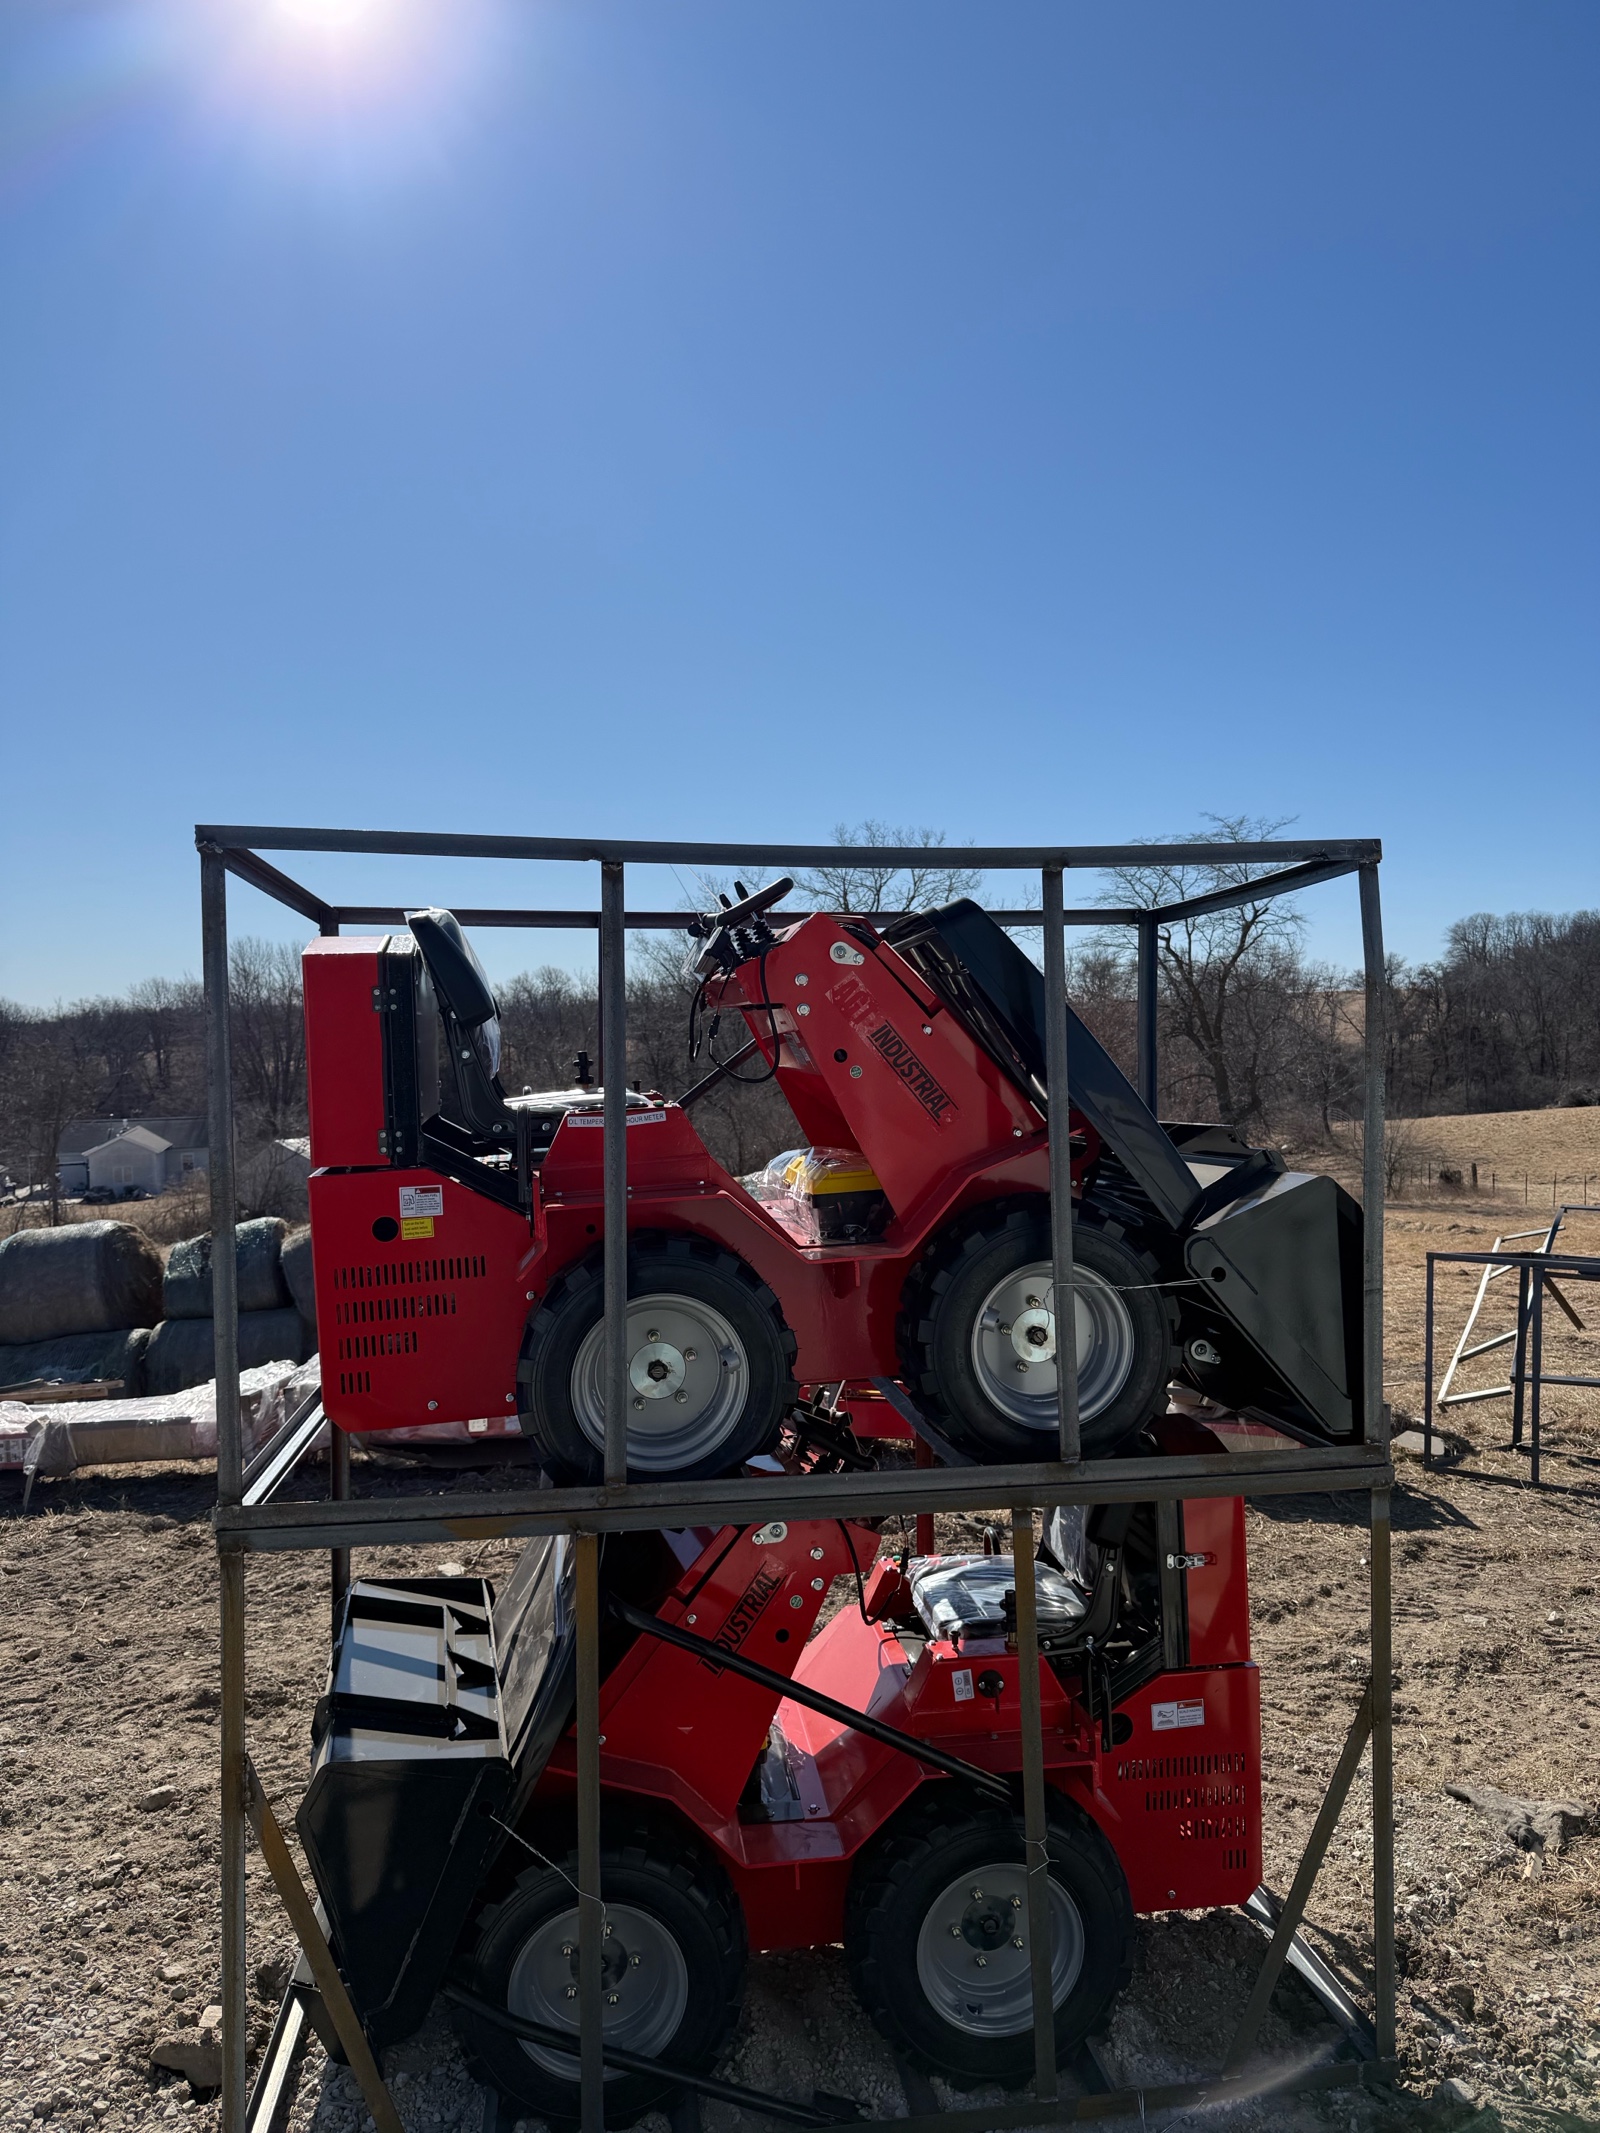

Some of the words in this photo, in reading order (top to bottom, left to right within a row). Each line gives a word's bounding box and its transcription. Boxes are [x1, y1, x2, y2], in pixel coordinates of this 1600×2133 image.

[644, 1113, 664, 1121] METER
[870, 1024, 950, 1119] INDUSTRIAL
[700, 1571, 781, 1675] IDUSTRIAL
